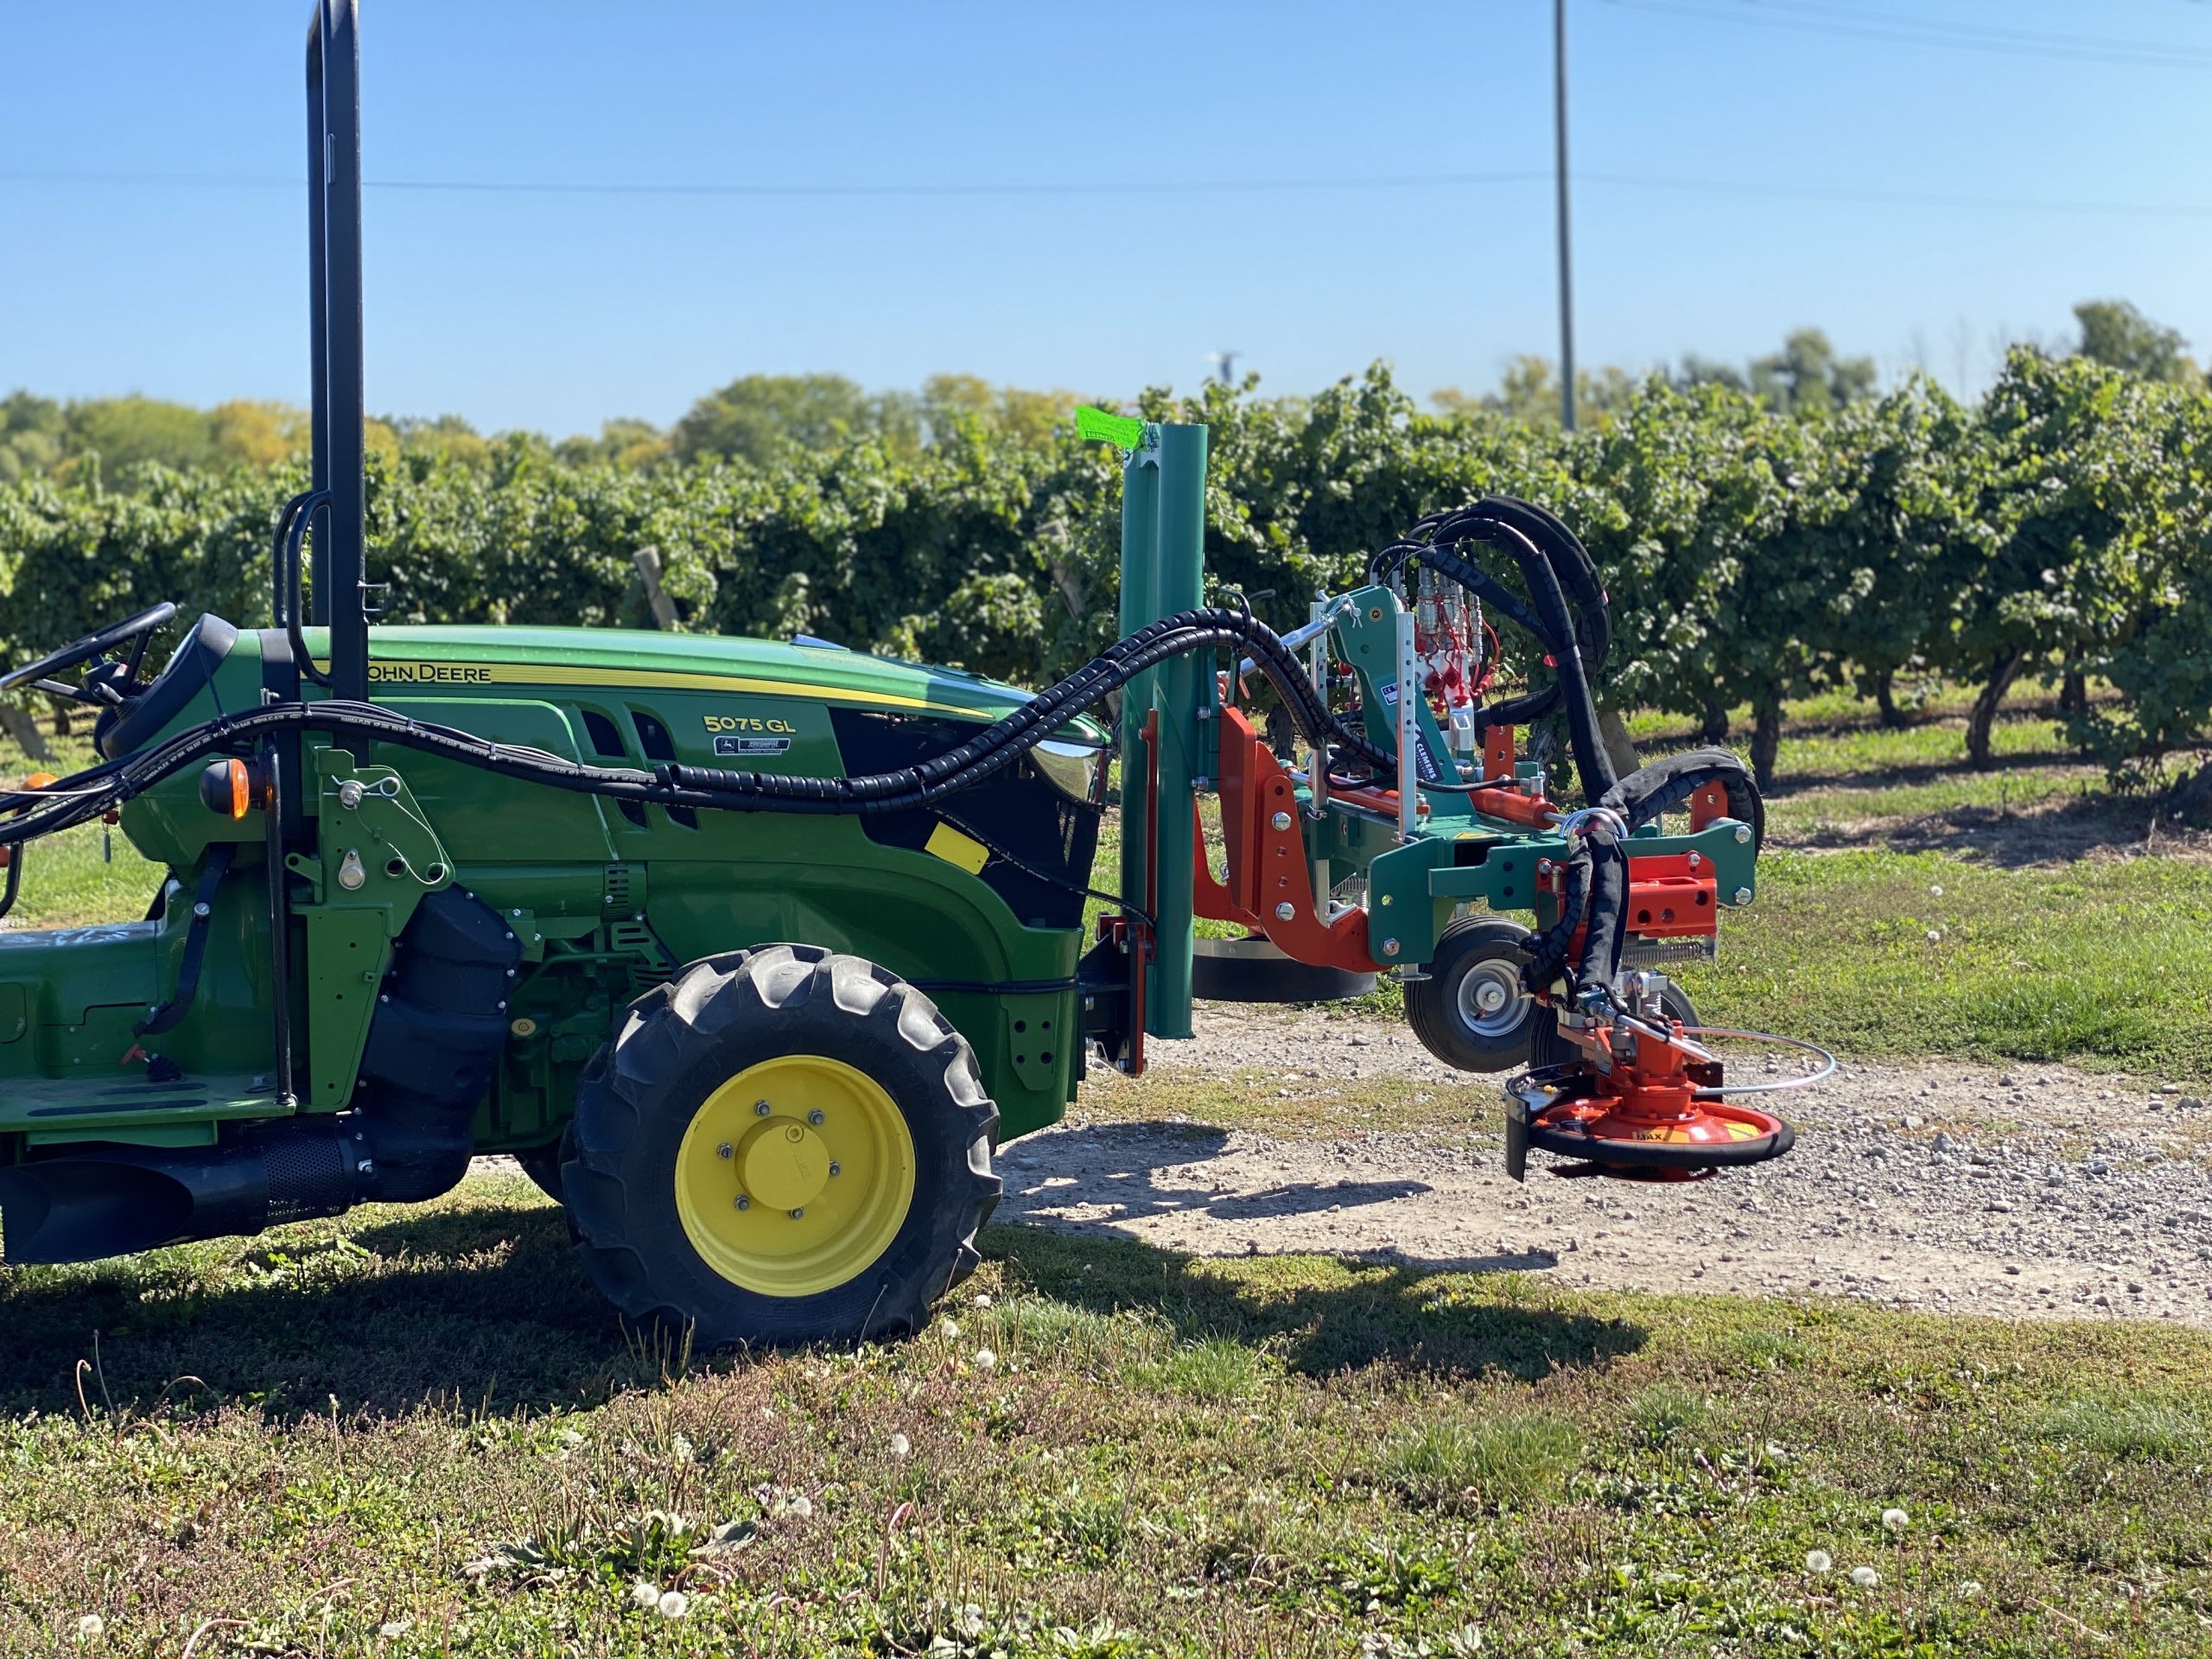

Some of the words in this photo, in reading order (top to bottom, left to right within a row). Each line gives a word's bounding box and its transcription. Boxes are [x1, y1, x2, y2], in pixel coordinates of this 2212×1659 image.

[368, 665, 413, 680] OHN
[419, 664, 491, 682] DEERE
[703, 715, 763, 733] 5075
[766, 719, 797, 733] GL
[1417, 743, 1437, 779] CLEMENS
